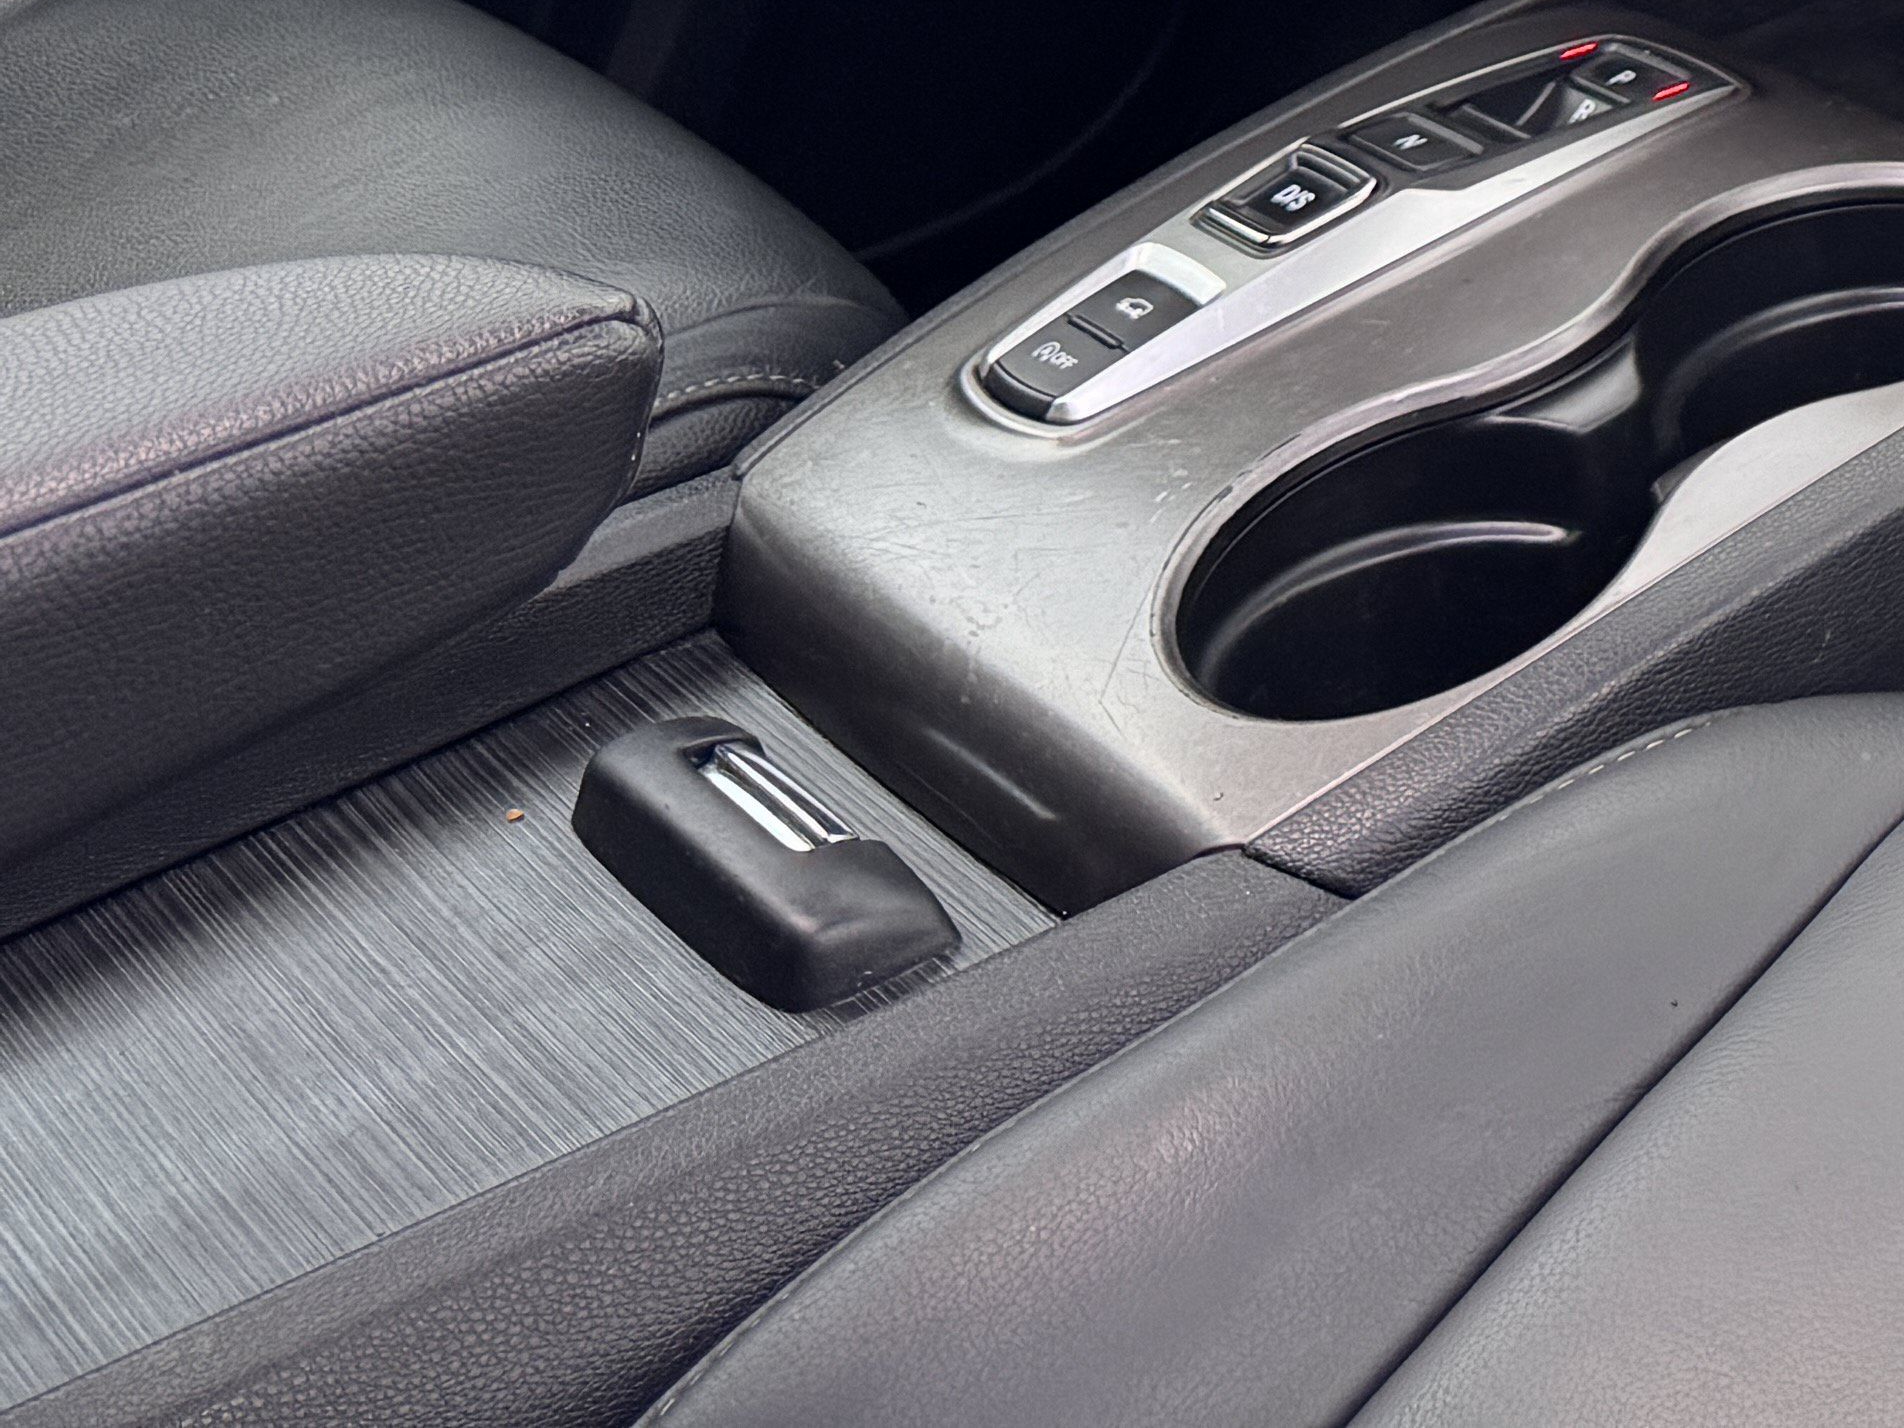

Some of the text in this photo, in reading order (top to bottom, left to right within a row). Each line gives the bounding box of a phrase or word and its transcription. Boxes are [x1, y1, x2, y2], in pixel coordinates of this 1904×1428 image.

[1605, 68, 1638, 87] P
[1569, 98, 1597, 126] R
[1393, 133, 1428, 151] N
[1270, 183, 1317, 213] D/S
[1049, 351, 1080, 371] OFF
